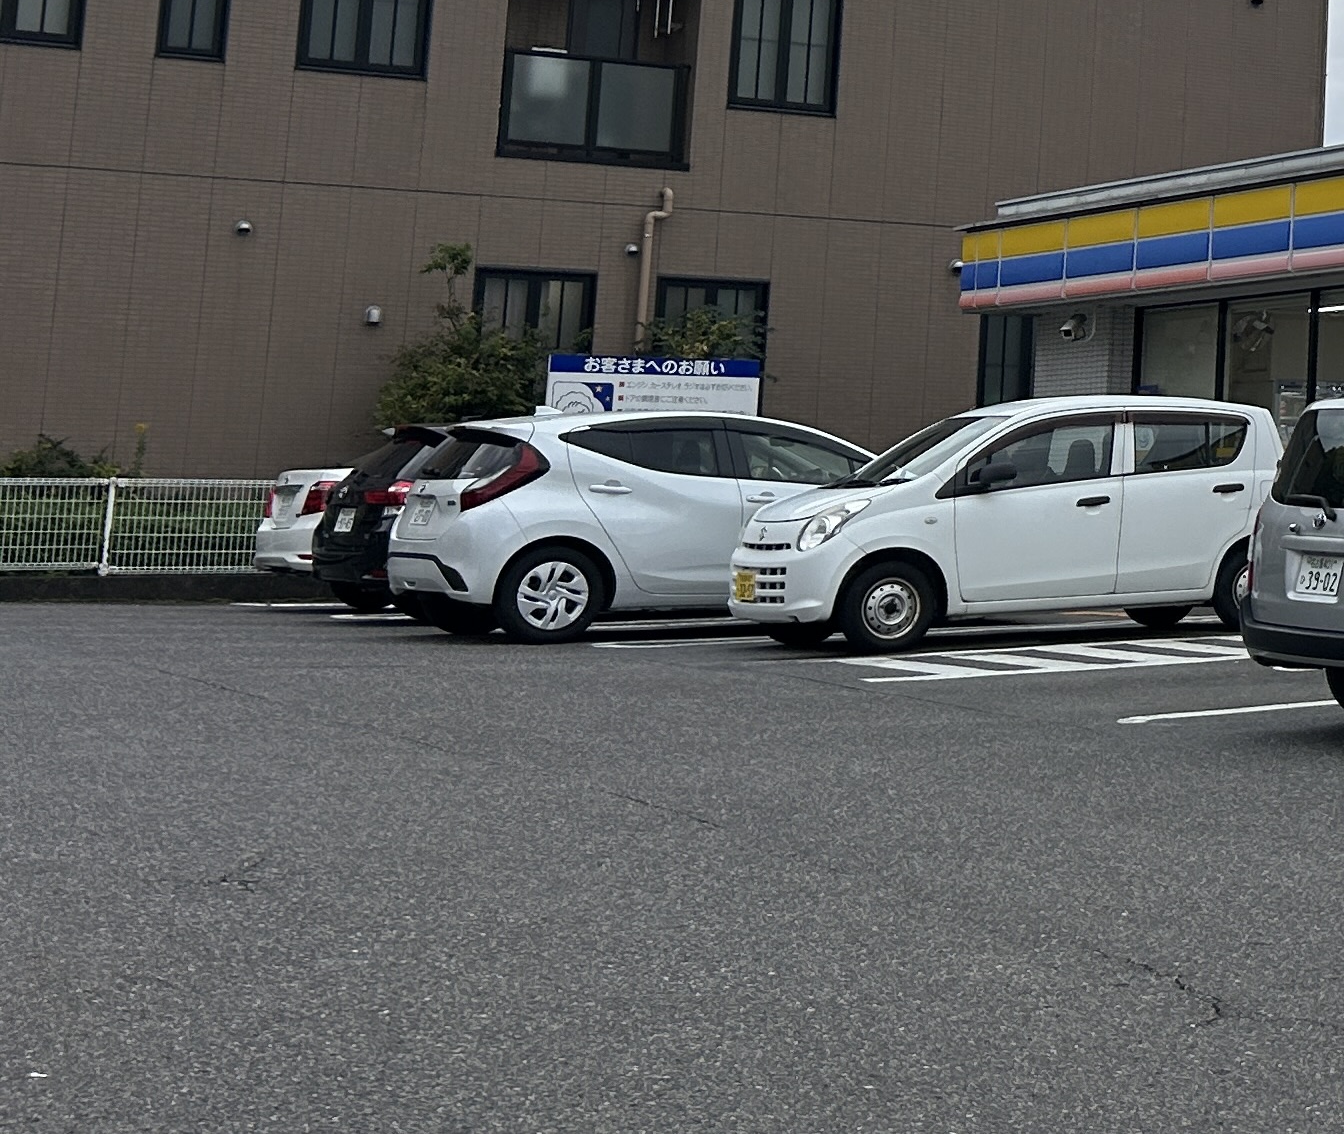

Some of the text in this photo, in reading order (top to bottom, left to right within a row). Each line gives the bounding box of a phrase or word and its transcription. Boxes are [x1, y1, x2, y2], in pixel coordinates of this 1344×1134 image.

[584, 357, 726, 375] お客さまへのお願い
[1304, 570, 1338, 593] 39-02
